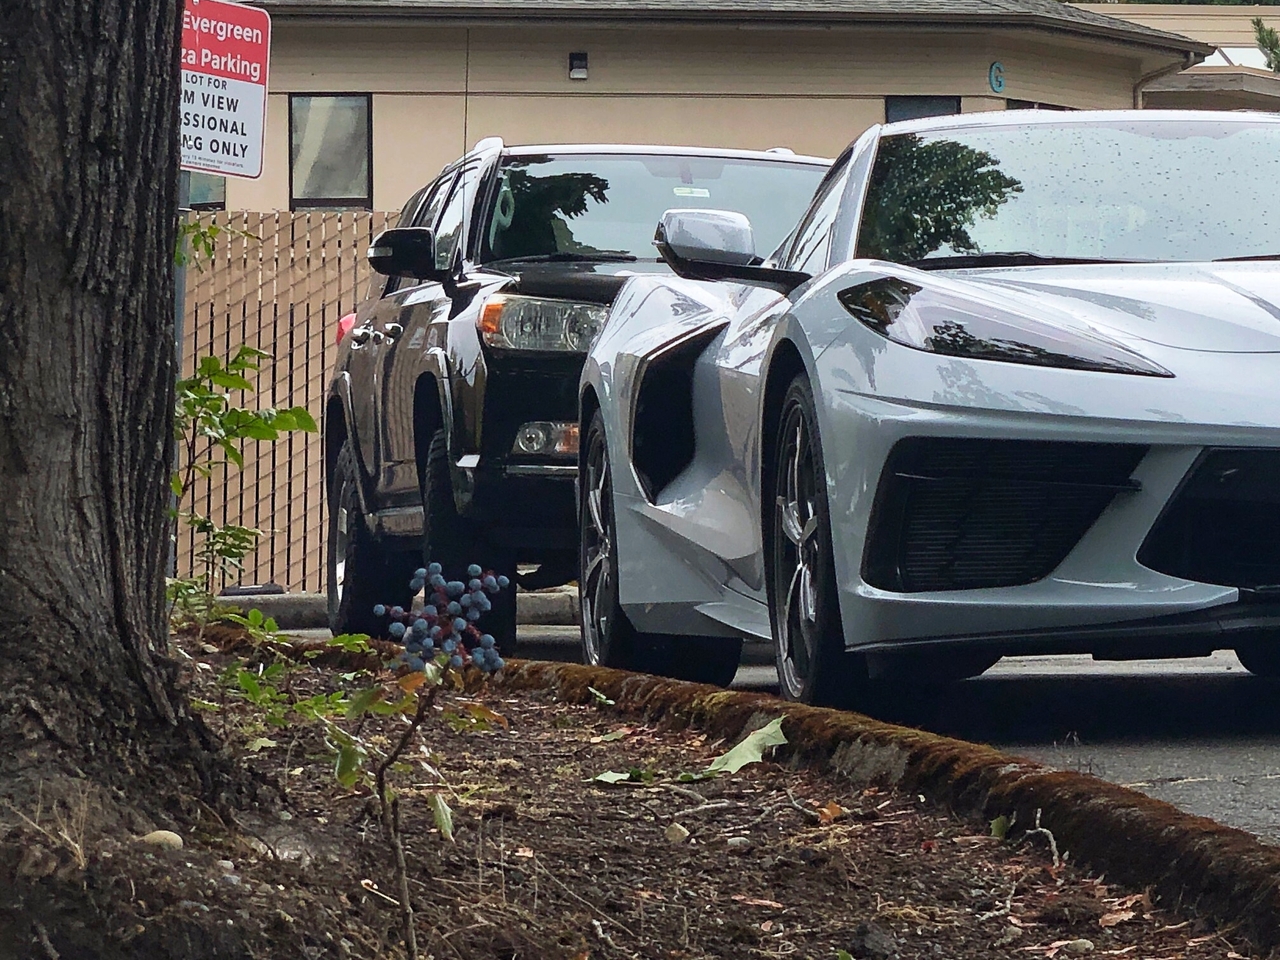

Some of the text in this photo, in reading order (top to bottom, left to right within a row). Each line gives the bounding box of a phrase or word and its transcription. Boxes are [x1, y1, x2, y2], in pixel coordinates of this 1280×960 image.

[183, 10, 262, 44] Evergreen
[181, 48, 261, 82] za Parking
[988, 61, 1005, 93] G
[185, 73, 227, 90] LOT FOR
[183, 89, 240, 113] M VIEW
[181, 111, 247, 136] SSIONAL
[181, 134, 248, 159] NG ONLY
